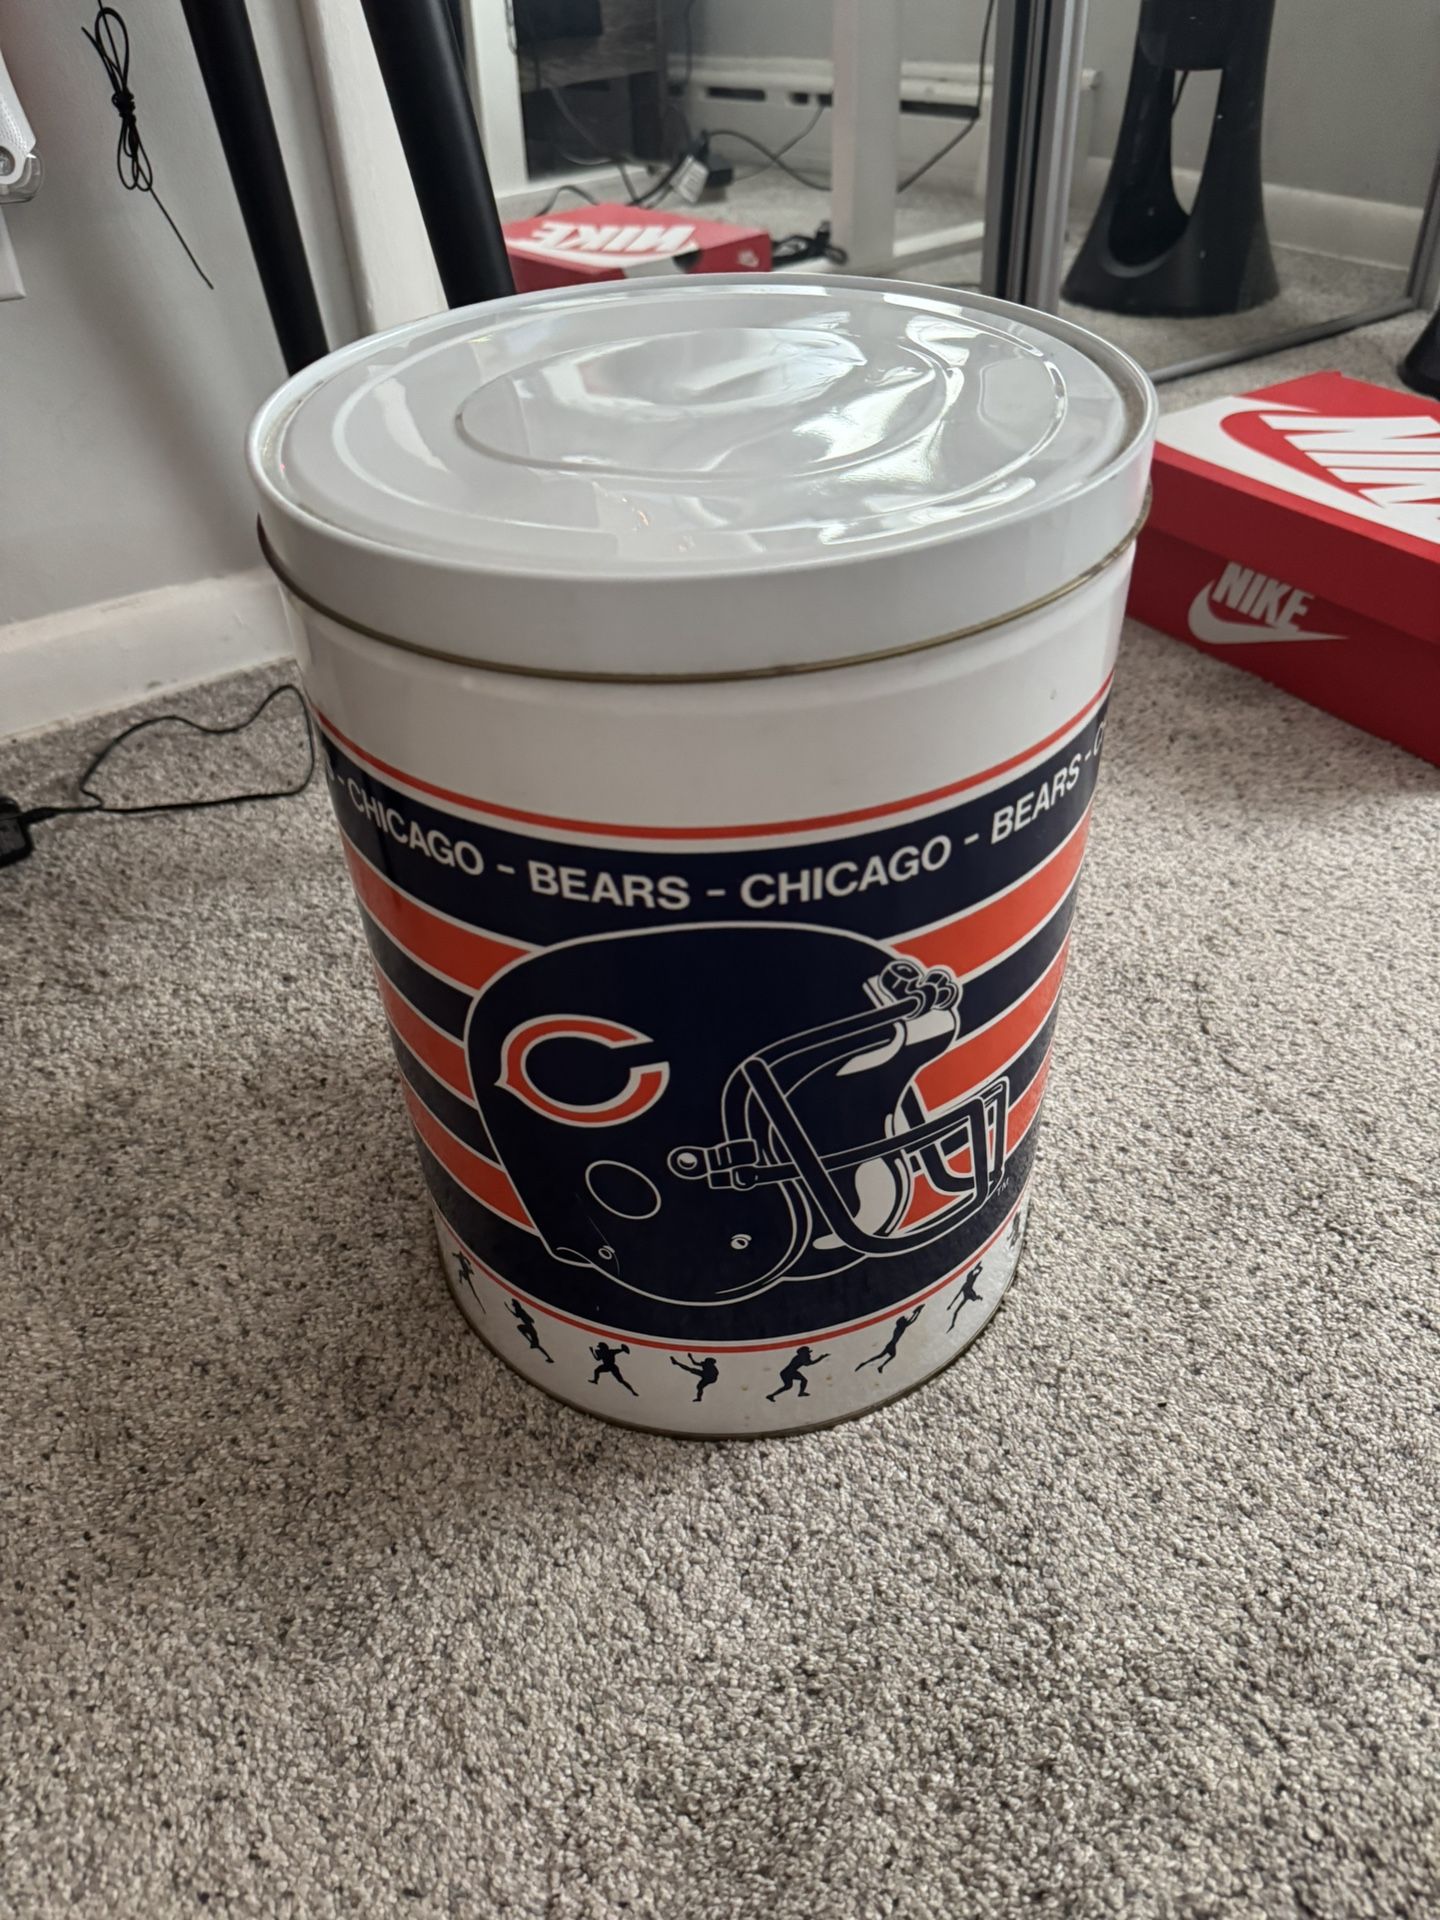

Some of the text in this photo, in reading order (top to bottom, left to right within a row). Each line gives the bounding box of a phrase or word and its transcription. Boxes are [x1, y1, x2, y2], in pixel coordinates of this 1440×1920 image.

[1211, 560, 1315, 632] NIKE
[346, 777, 485, 876] CHICAGO
[528, 860, 690, 910] BEARS
[740, 834, 952, 909] CHICAGO
[990, 753, 1081, 845] BEARS
